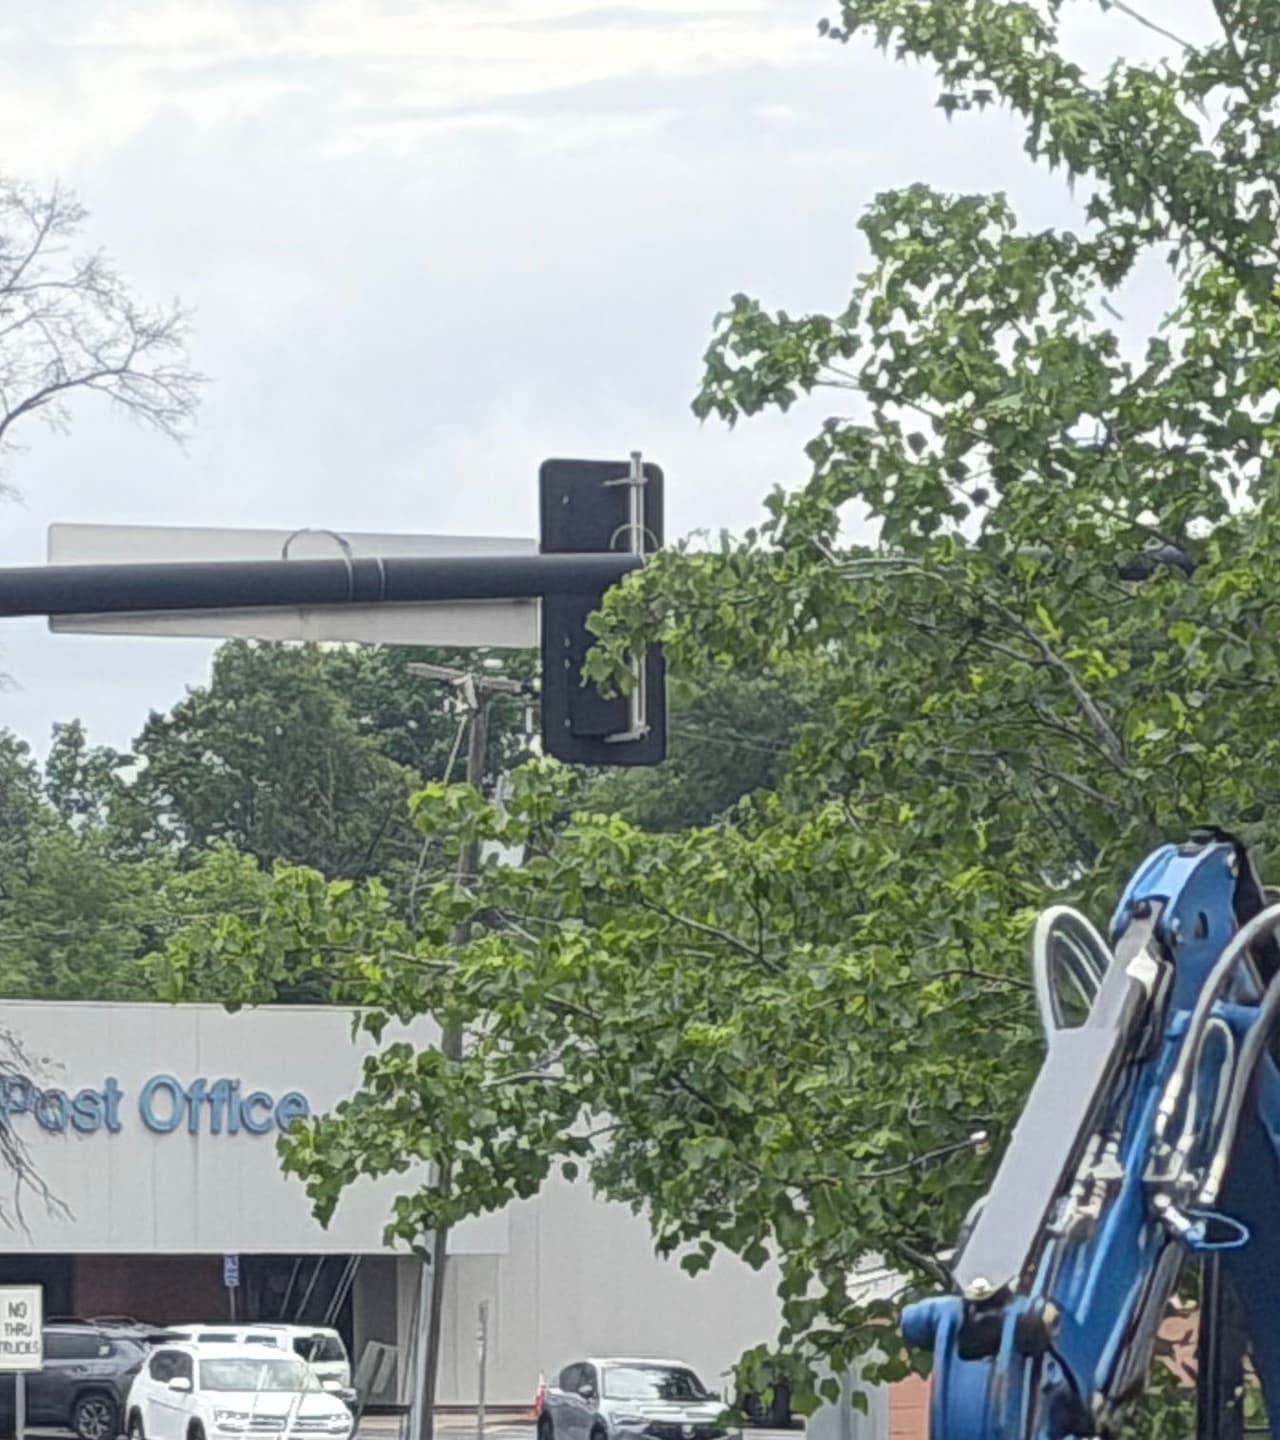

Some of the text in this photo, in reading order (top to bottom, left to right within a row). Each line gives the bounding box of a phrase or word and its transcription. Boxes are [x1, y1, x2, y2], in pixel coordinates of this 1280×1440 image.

[0, 1073, 123, 1134] Post
[138, 1074, 310, 1135] Office
[8, 1301, 28, 1318] NO
[4, 1322, 33, 1336] THRU
